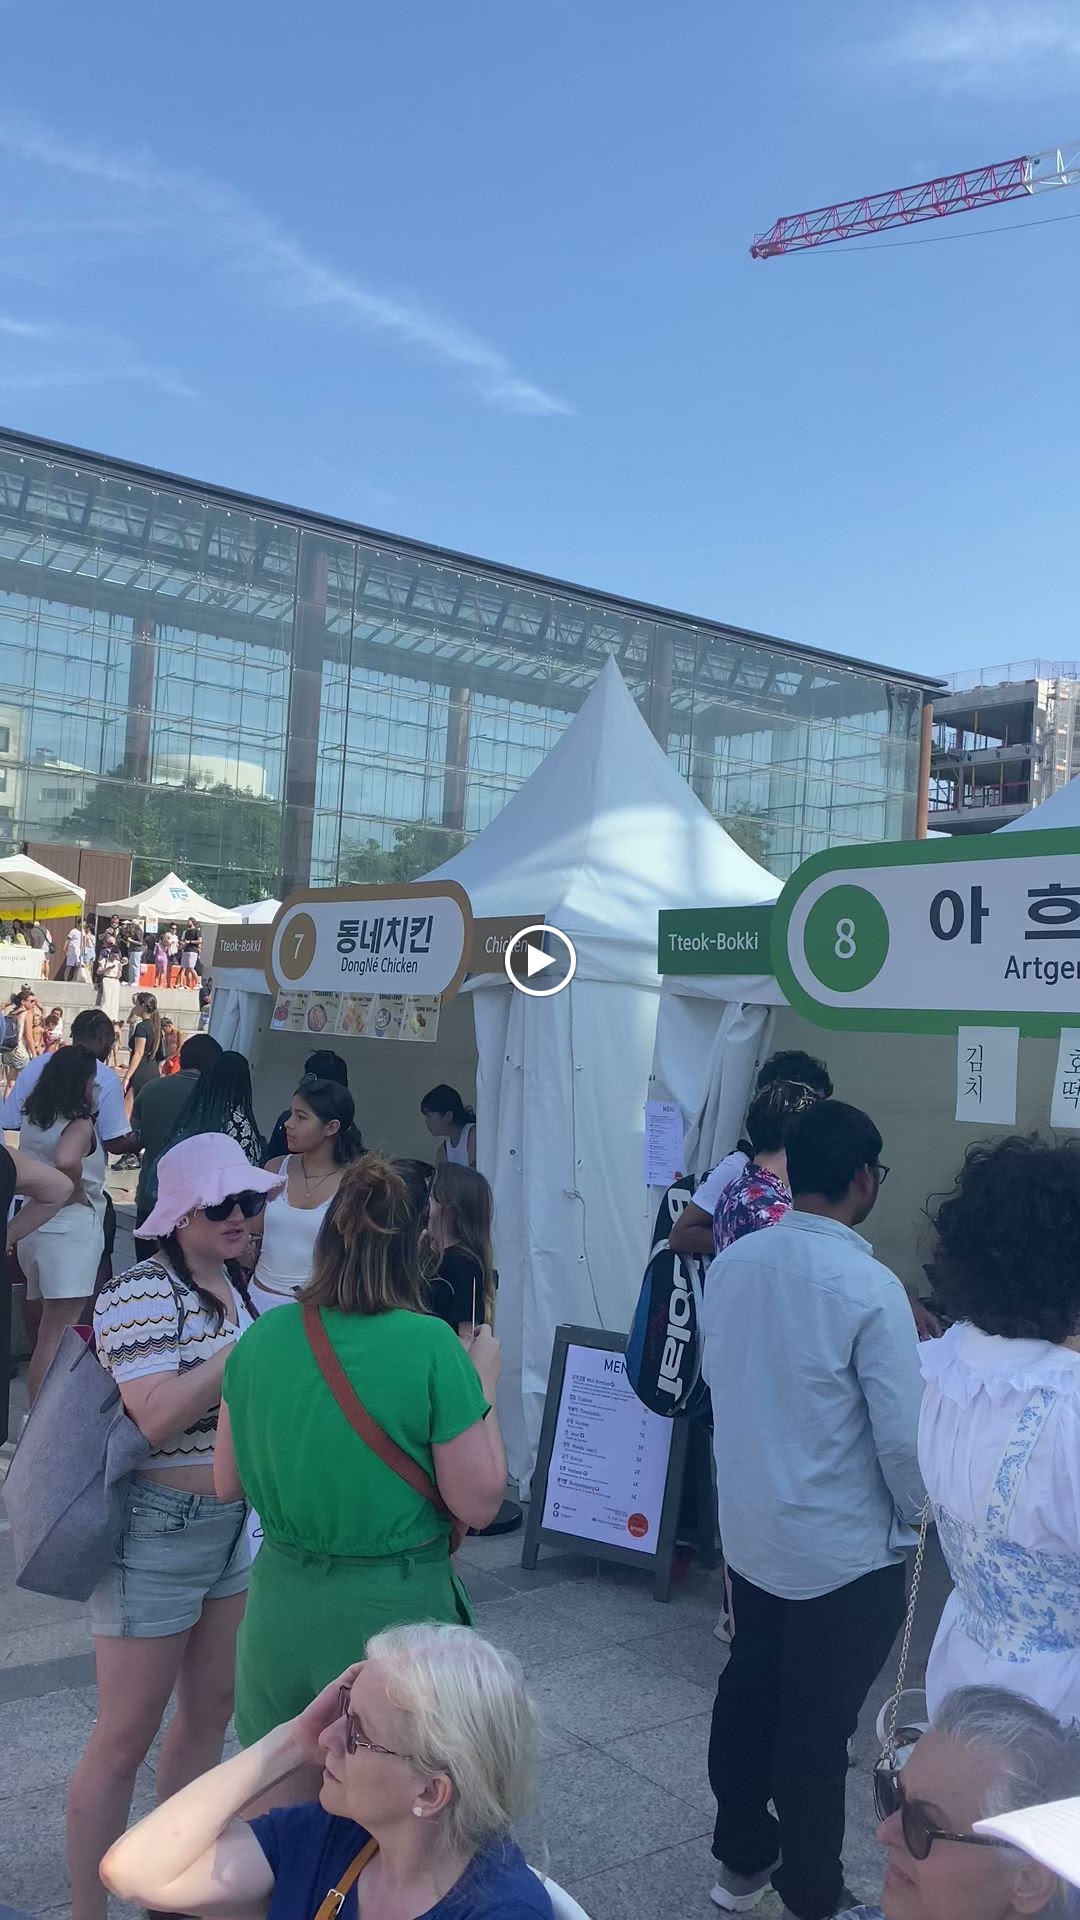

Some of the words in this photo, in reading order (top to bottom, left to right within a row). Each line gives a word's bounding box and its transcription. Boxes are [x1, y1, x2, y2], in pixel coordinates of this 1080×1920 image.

[929, 885, 990, 945] 아
[336, 914, 434, 954] 동네치킨
[485, 935, 528, 954] Chicen
[668, 931, 759, 951] Tteok-Bokki
[834, 917, 856, 960] 8
[220, 939, 262, 953] Tteok-Bokki
[293, 933, 305, 960] 7
[341, 957, 379, 976] DongNé
[381, 957, 418, 974] Chicken
[964, 1044, 983, 1104] 김치
[603, 1358, 628, 1375] MEN
